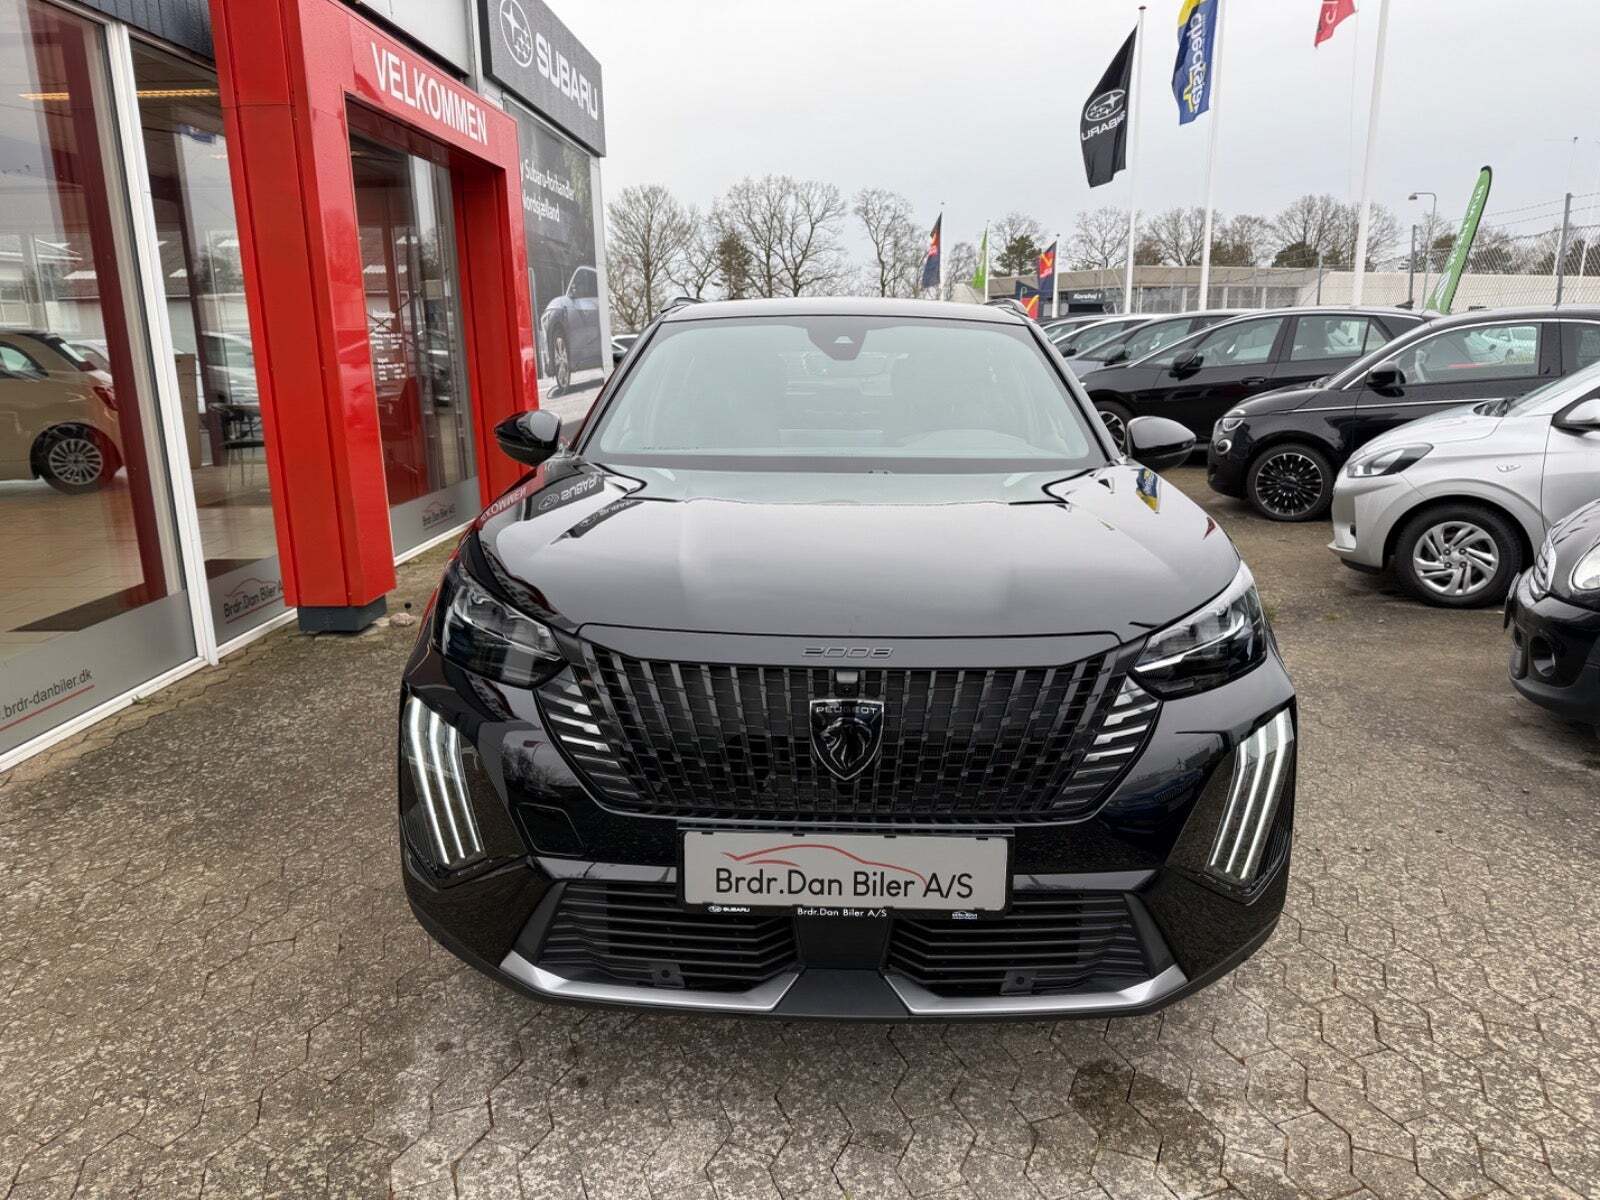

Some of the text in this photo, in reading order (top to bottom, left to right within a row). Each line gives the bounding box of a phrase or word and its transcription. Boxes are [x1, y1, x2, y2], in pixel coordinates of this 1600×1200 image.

[535, 32, 599, 121] SUBARU
[371, 41, 488, 146] VELKOMMEN
[260, 584, 277, 602] Biler
[802, 647, 895, 659] 2008
[716, 868, 974, 899] Brdr.Dan Biler A/S
[797, 908, 888, 918] Brdr.Dan Biler A/S
